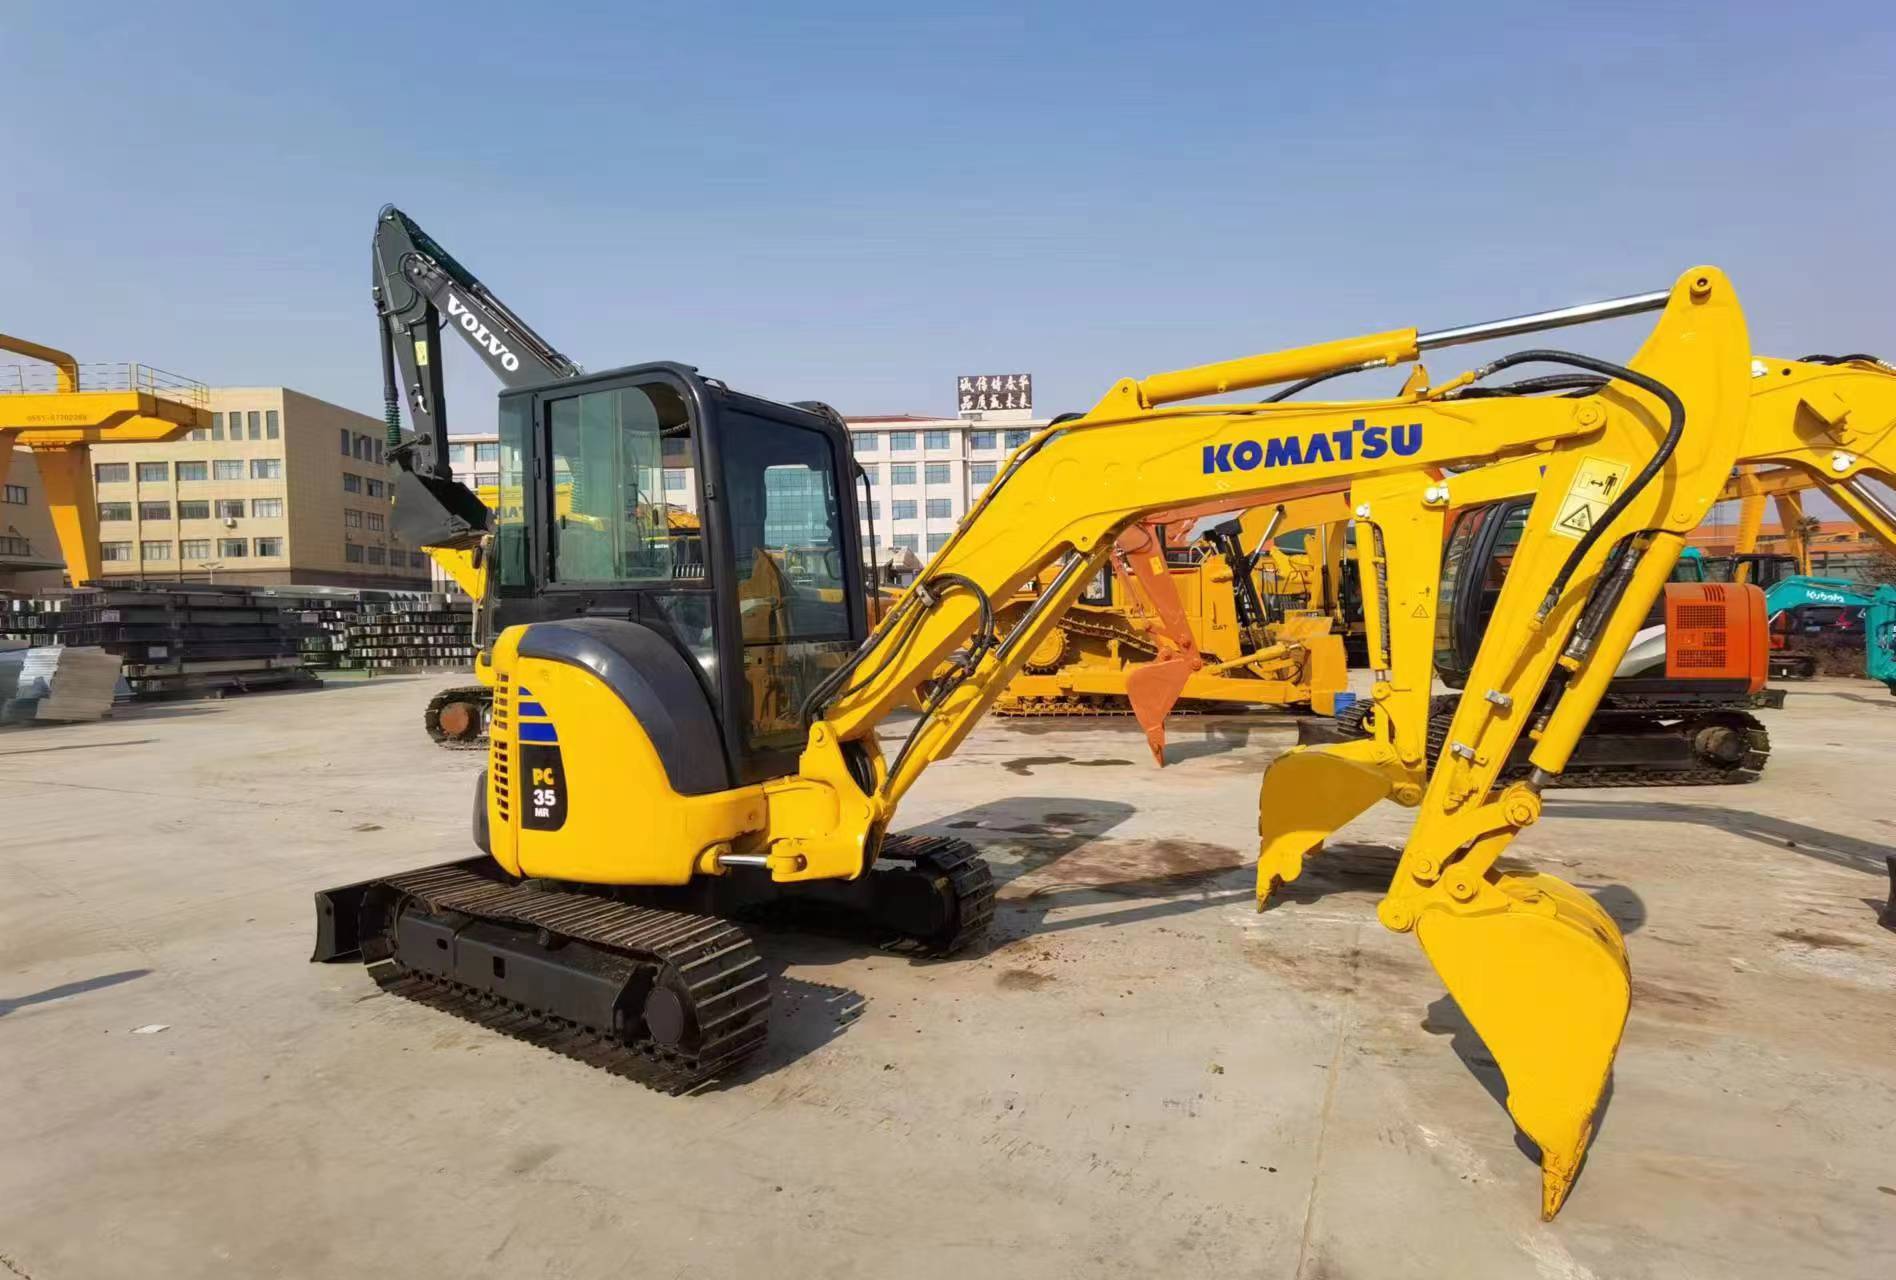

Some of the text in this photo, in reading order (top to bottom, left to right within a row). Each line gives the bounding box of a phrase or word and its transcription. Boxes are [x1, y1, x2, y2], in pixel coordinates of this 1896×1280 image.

[447, 293, 519, 371] VOLVO
[1202, 419, 1423, 475] KOMATSU
[1806, 590, 1844, 603] Kubota
[532, 767, 555, 786] PC
[533, 789, 556, 806] 35
[534, 807, 550, 818] MR
